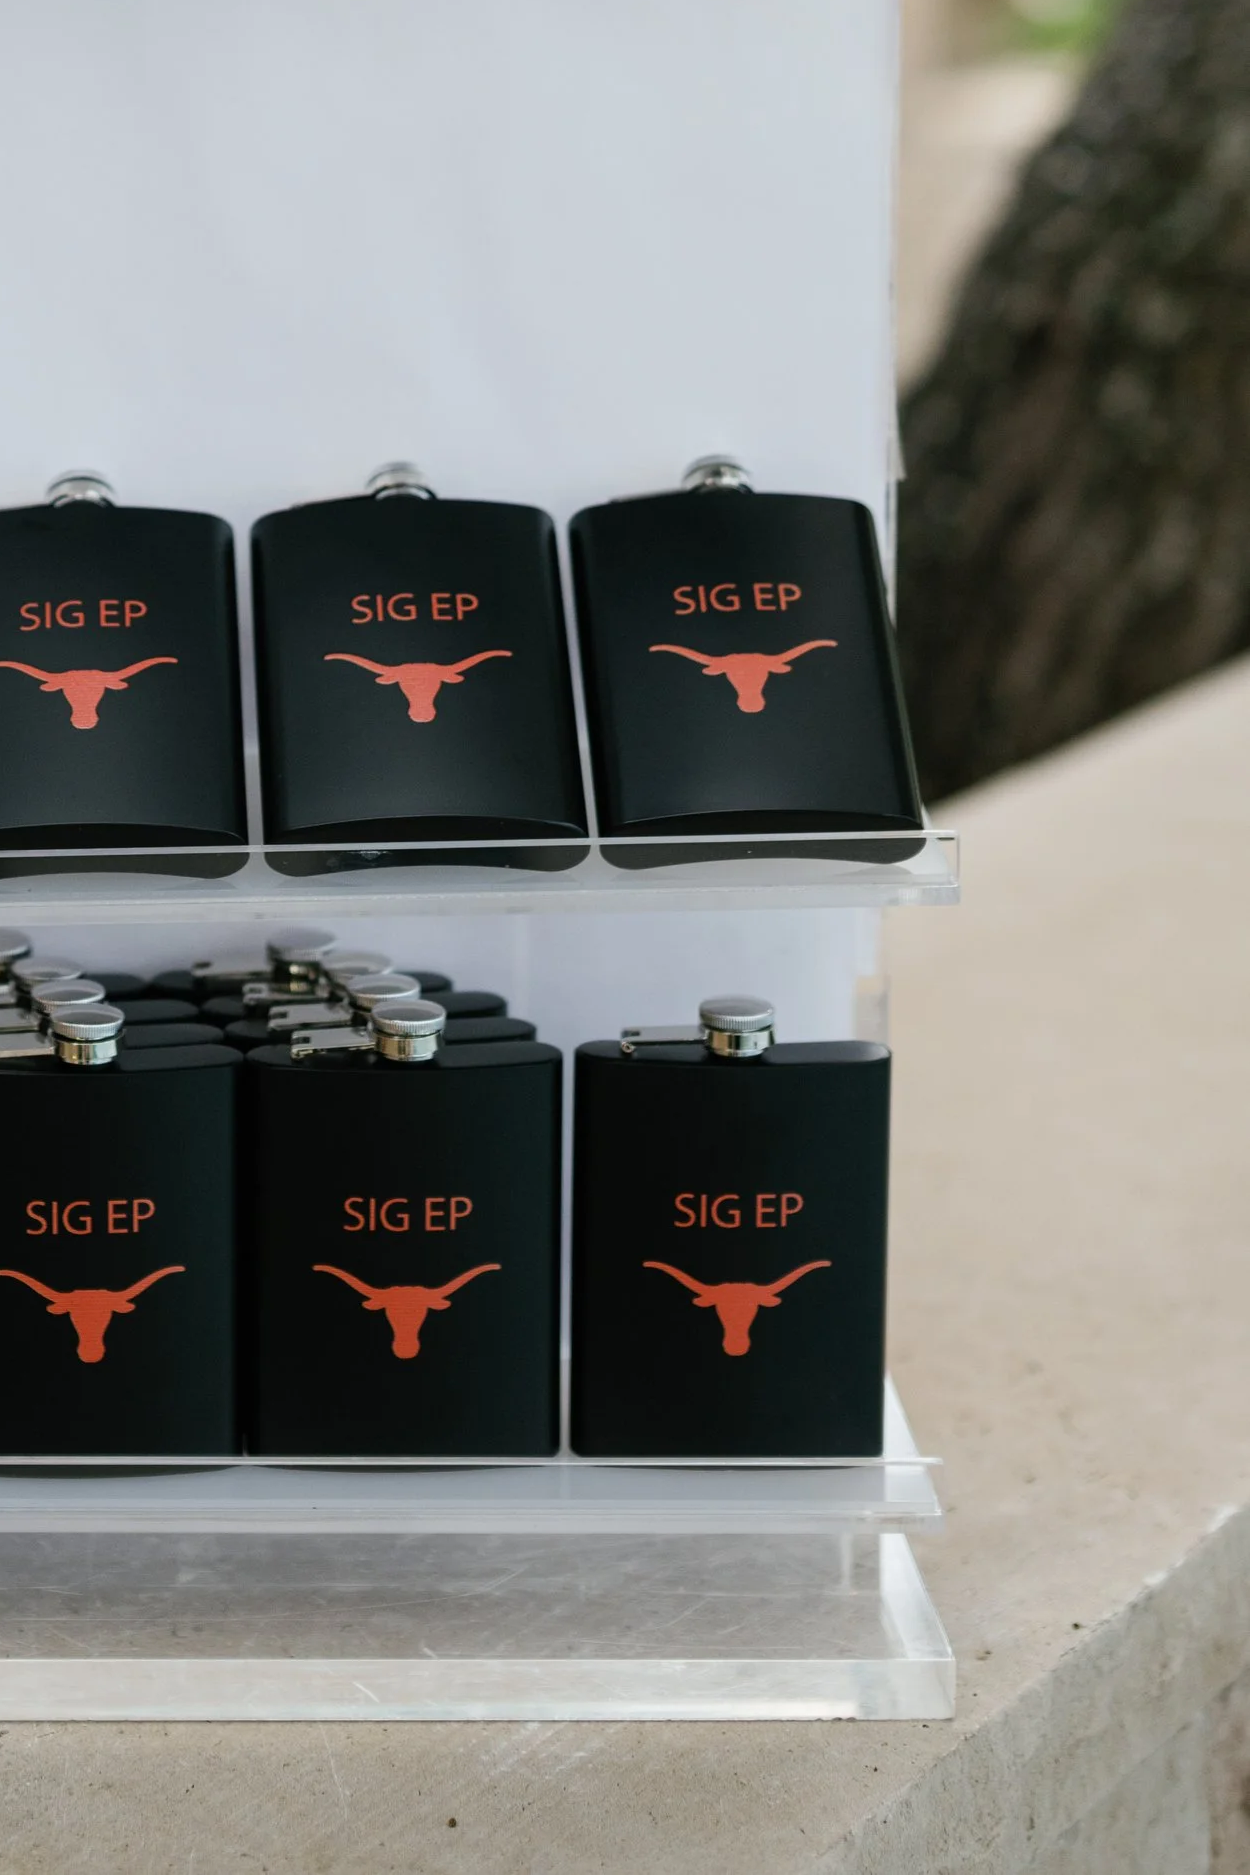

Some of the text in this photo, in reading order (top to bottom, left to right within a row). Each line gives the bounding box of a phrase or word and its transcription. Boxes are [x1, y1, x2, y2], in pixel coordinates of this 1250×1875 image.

[19, 598, 148, 632] SIG EP
[350, 591, 479, 625] SIG EP
[673, 581, 802, 616] SIG EP
[25, 1197, 156, 1236] SIG EP
[343, 1196, 473, 1233] SIG EP
[673, 1191, 804, 1229] SIG EP
